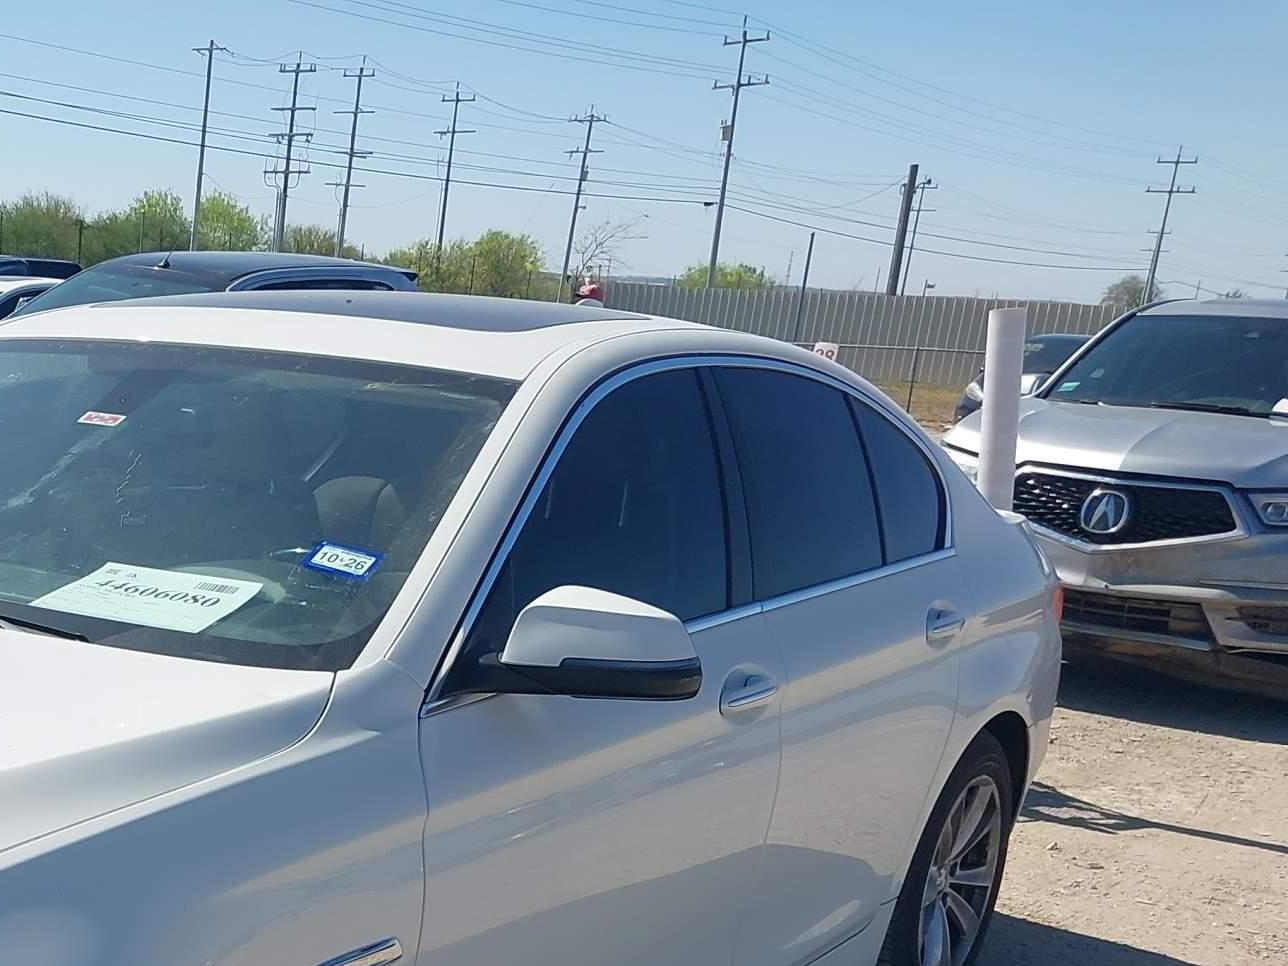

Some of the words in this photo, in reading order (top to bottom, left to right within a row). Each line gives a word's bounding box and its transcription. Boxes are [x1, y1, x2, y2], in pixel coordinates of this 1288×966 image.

[319, 551, 339, 563] 10
[344, 557, 368, 570] 26
[94, 579, 221, 608] 44606080
